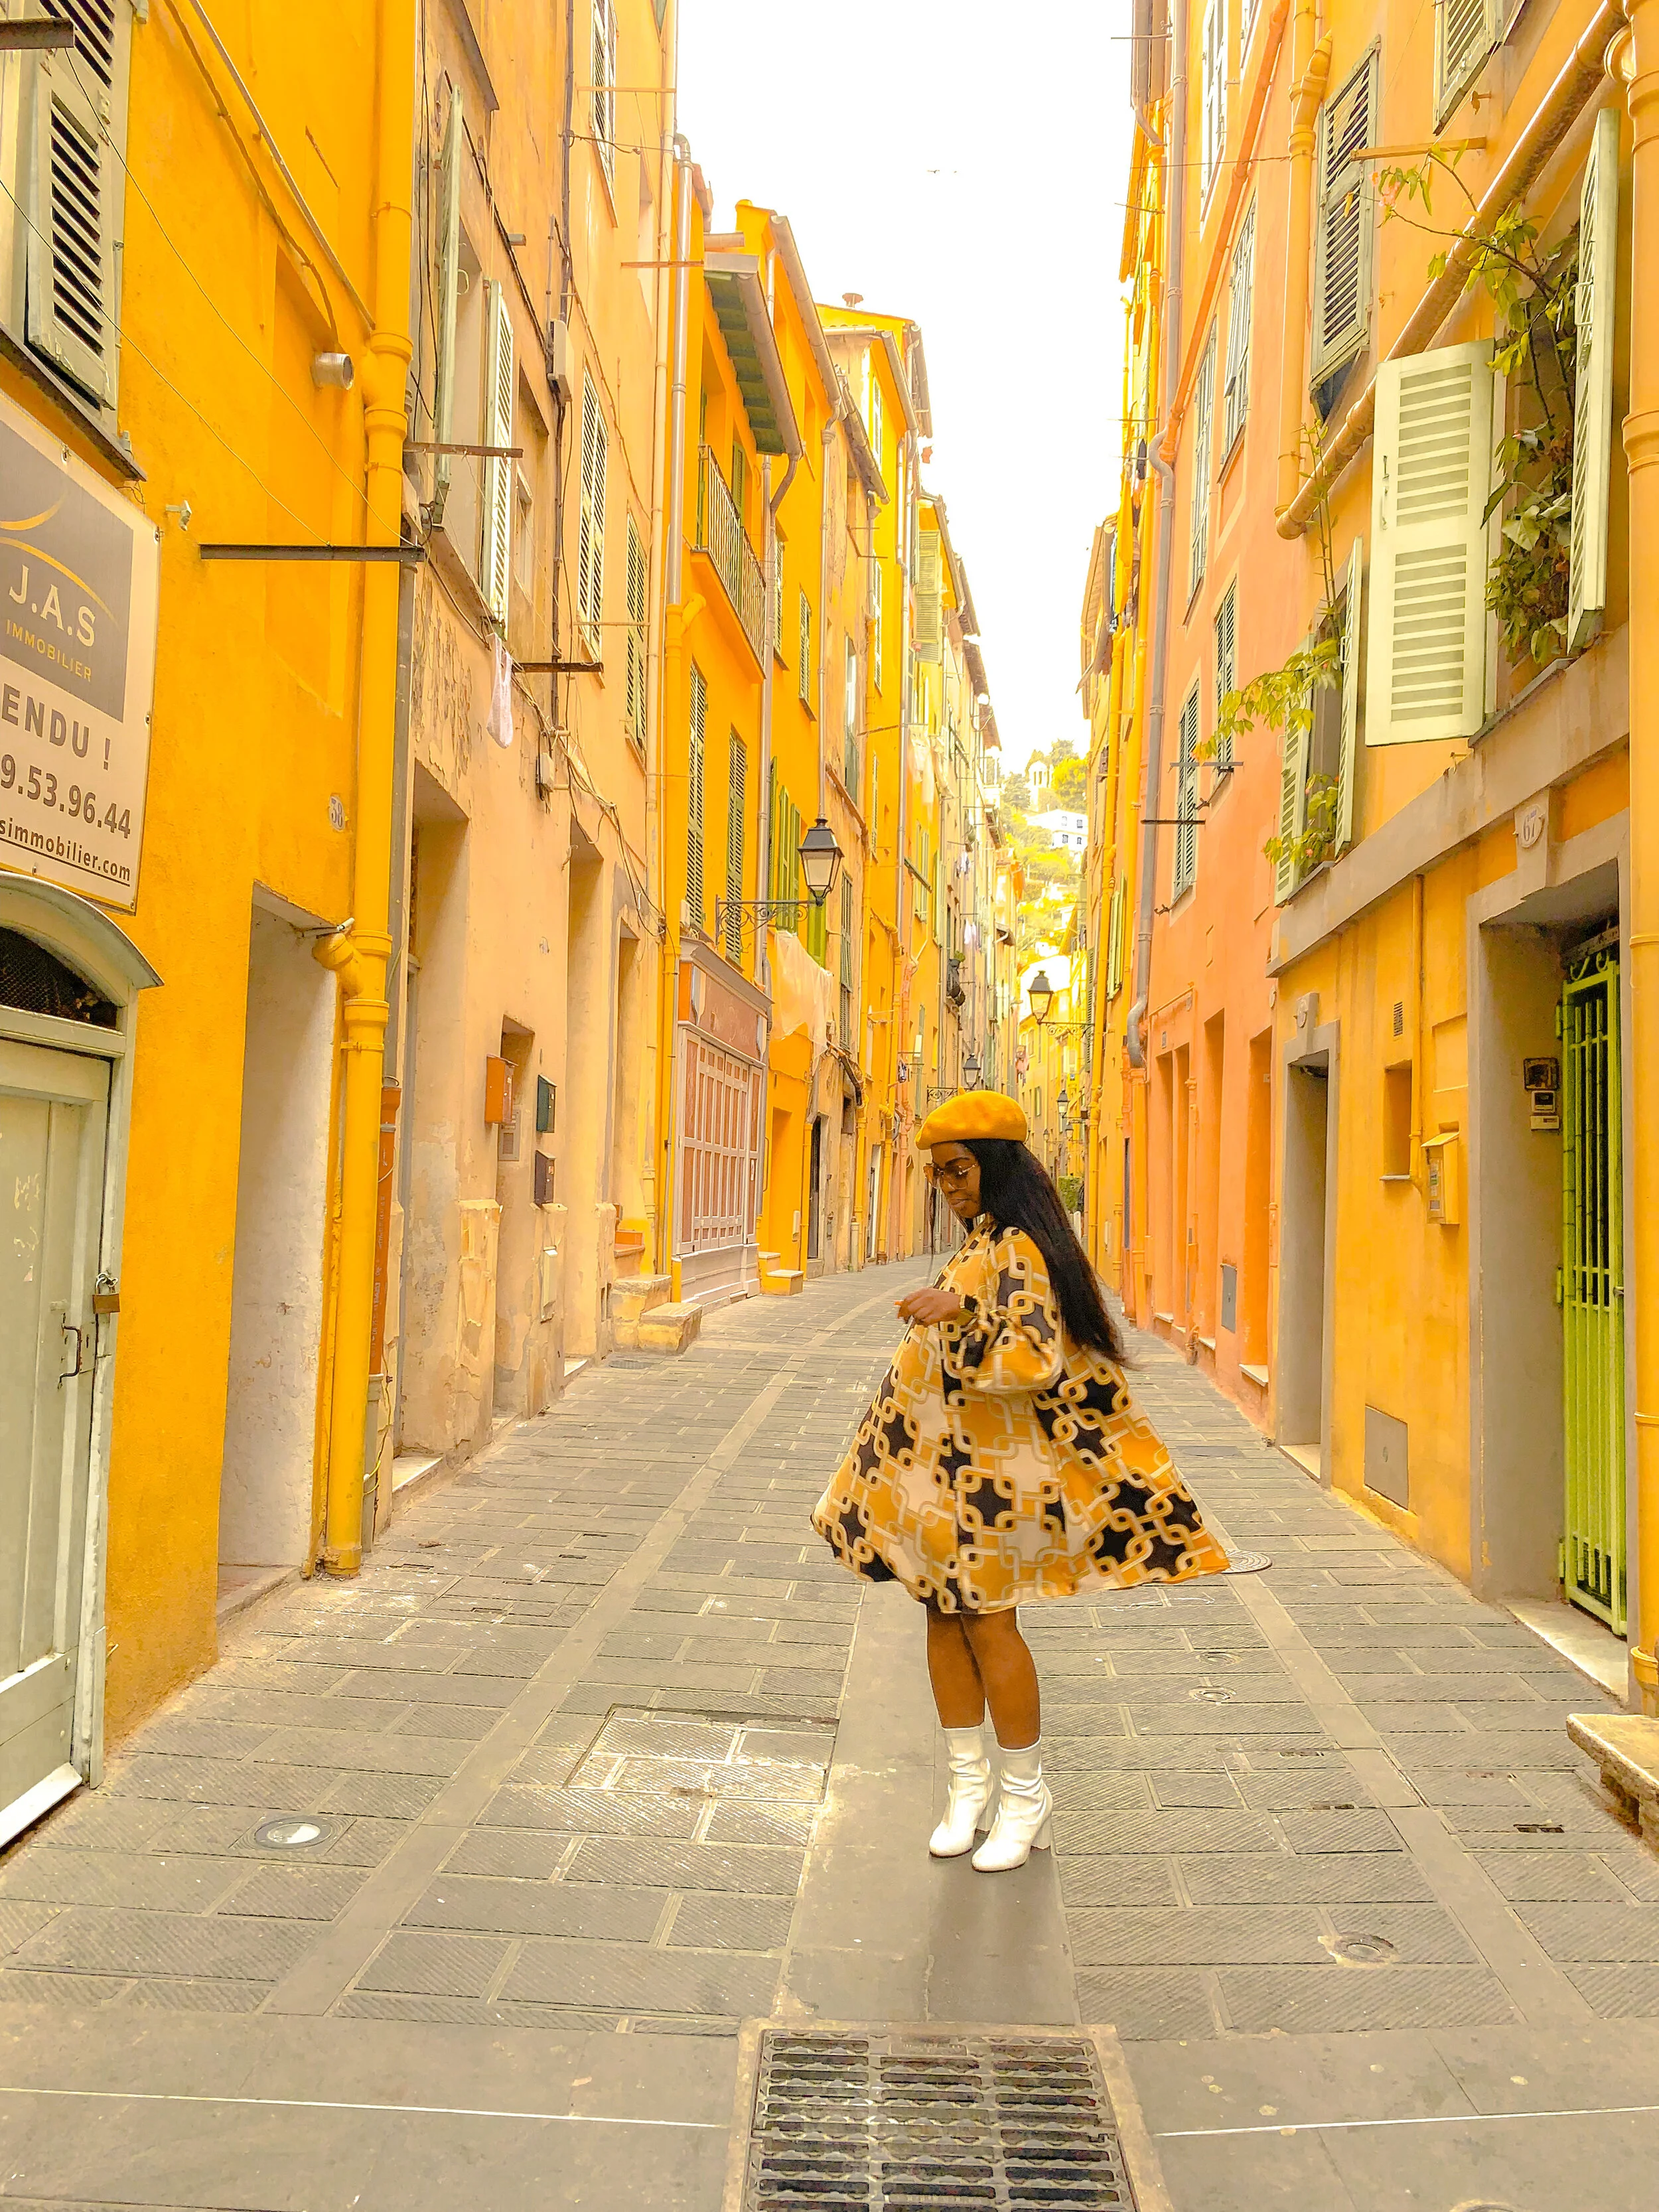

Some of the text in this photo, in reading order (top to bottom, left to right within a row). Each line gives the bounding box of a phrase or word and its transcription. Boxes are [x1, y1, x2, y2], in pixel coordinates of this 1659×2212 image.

[9, 564, 96, 647] J.A.S
[6, 619, 92, 682] IMMOBILIER
[1, 754, 131, 839] 9.53.96.44
[0, 817, 131, 881] simmobilier.com
